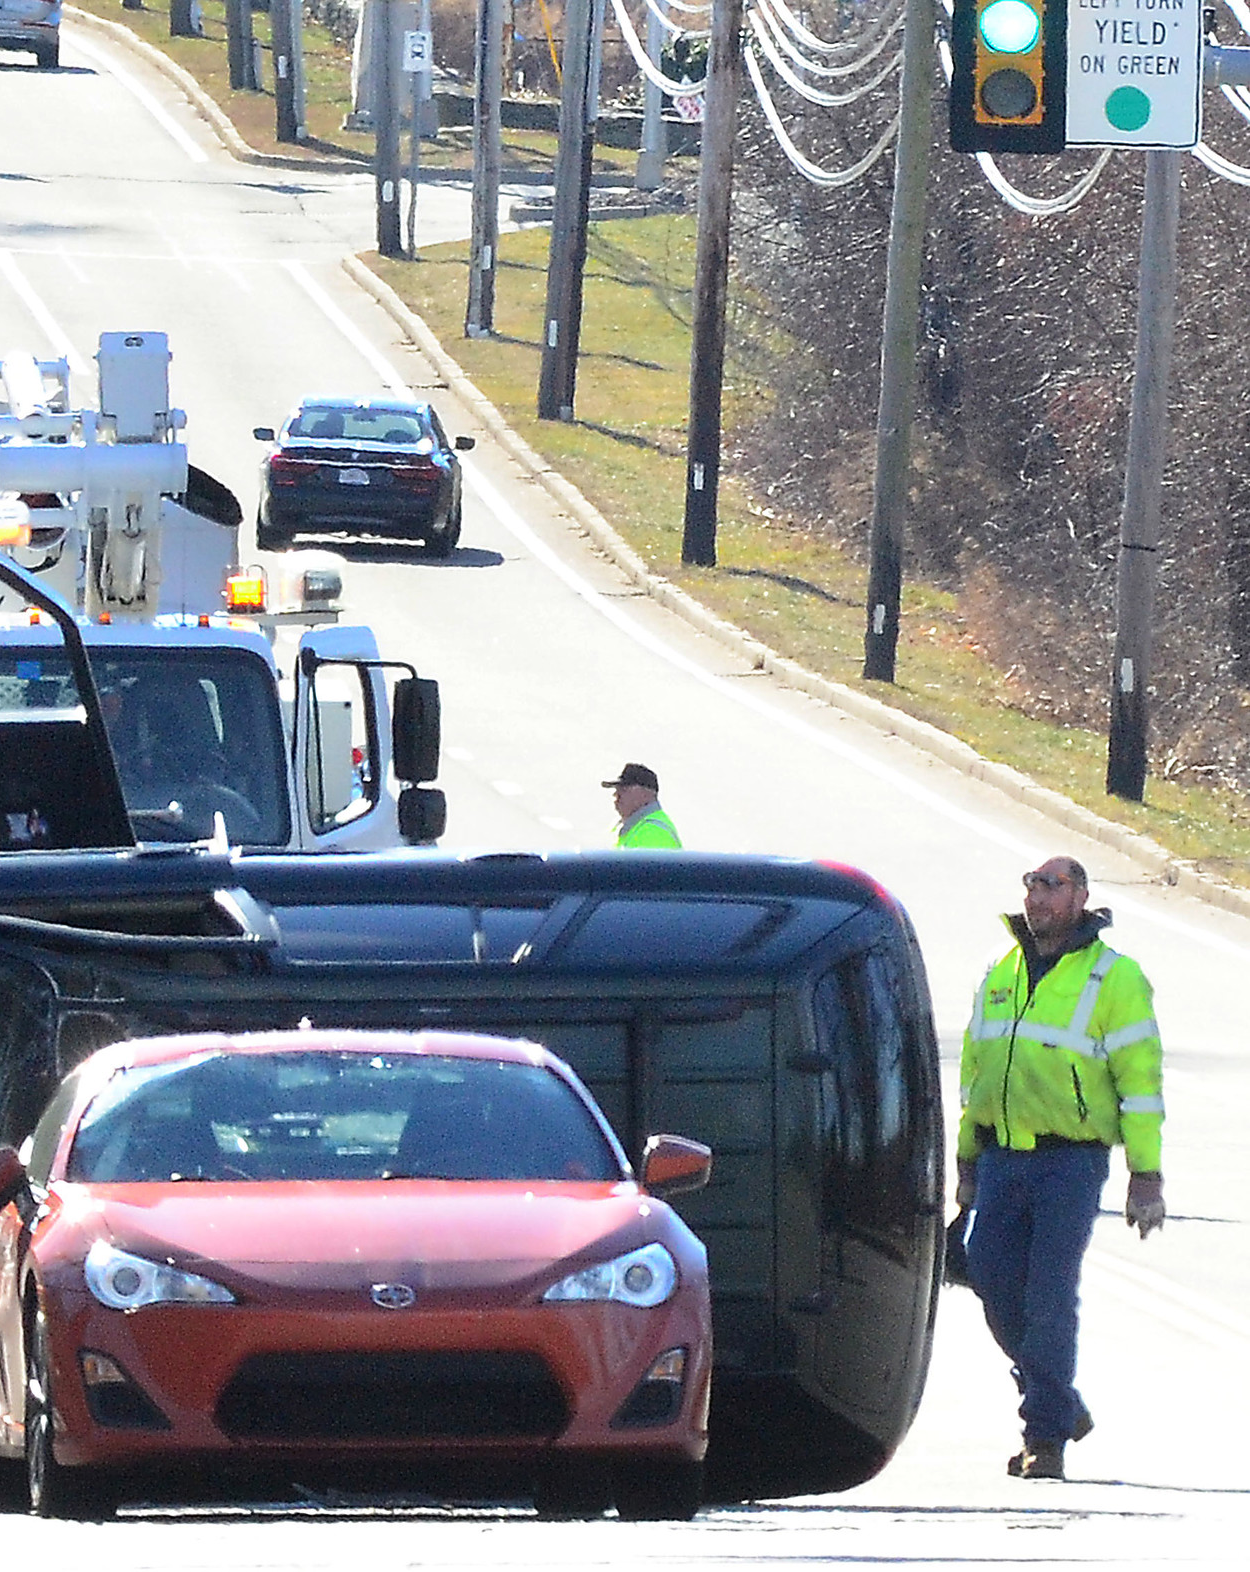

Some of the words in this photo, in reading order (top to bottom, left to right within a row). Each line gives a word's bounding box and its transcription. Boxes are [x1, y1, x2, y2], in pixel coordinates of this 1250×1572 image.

[1095, 19, 1166, 45] YIELD
[1080, 55, 1104, 73] ON
[1118, 55, 1180, 75] GREEN
